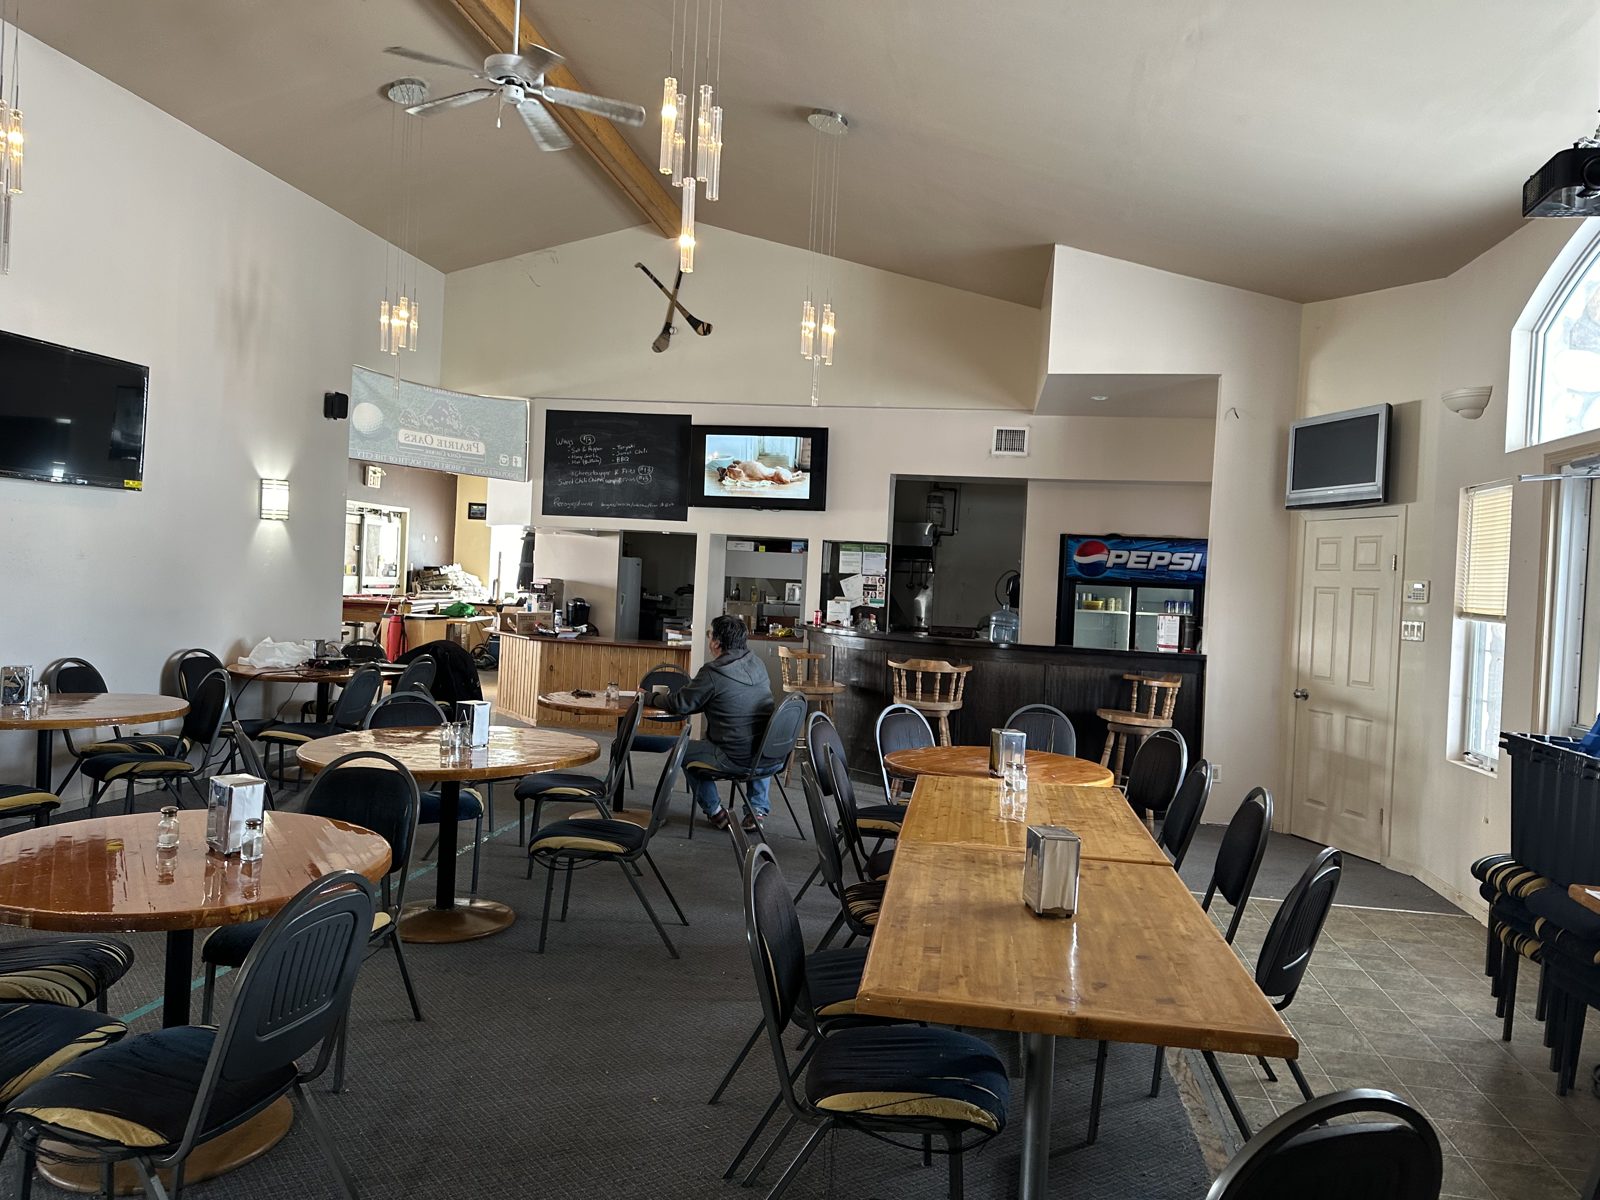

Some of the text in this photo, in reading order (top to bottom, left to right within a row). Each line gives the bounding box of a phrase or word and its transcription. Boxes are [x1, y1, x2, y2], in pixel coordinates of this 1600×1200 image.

[616, 454, 630, 463] BBQ
[369, 475, 380, 487] EXIT
[1105, 549, 1203, 572] PEPSI
